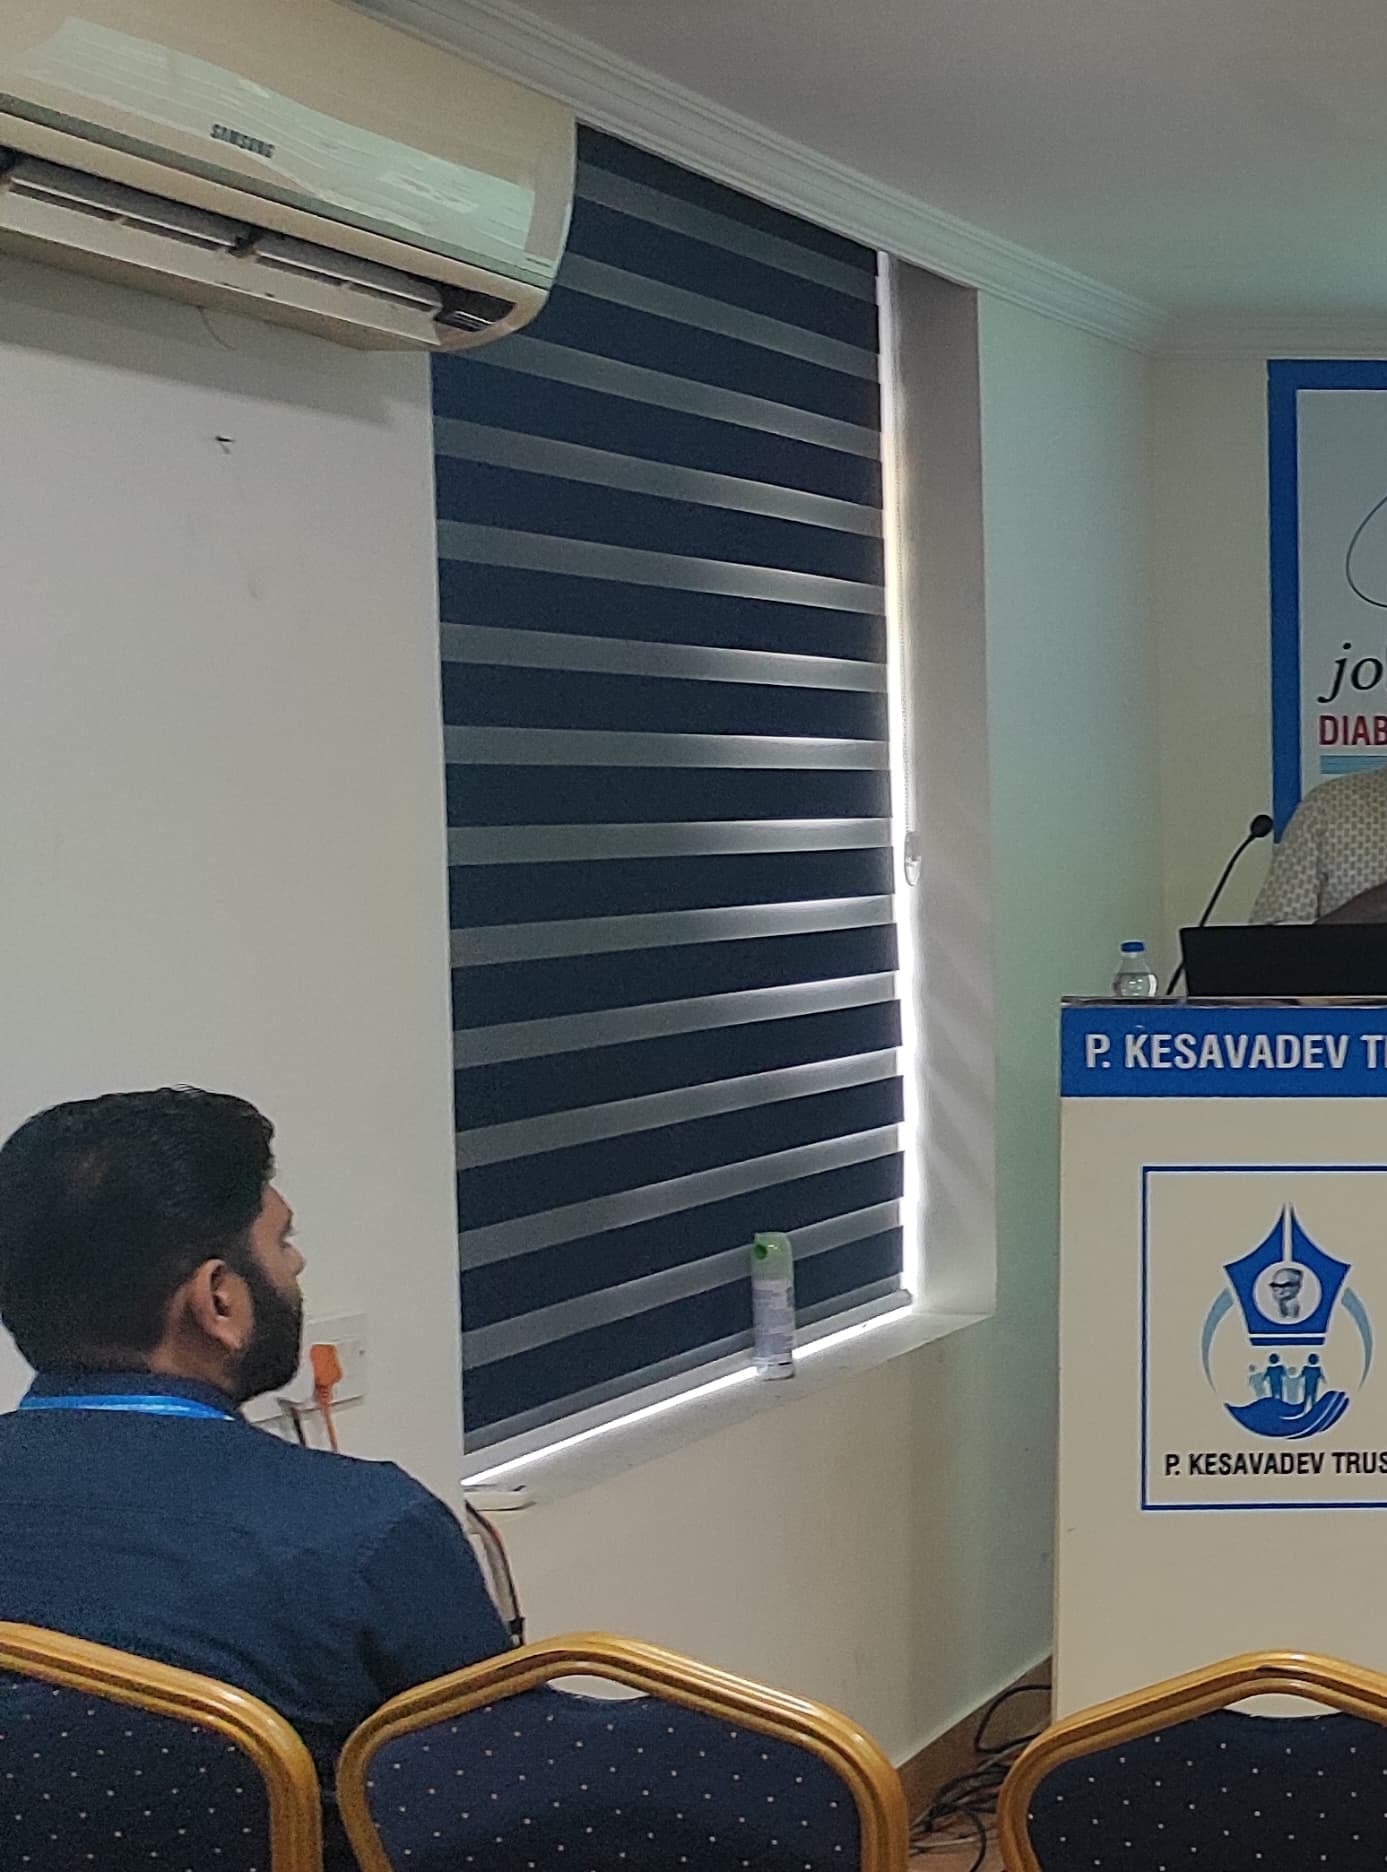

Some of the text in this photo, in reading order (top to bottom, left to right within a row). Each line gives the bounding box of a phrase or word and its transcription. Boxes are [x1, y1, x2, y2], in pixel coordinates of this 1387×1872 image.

[1084, 1033, 1111, 1069] P.
[1124, 1033, 1350, 1069] KESAVADEV
[1164, 1453, 1181, 1476] P.
[1189, 1452, 1325, 1475] KESAVADEV
